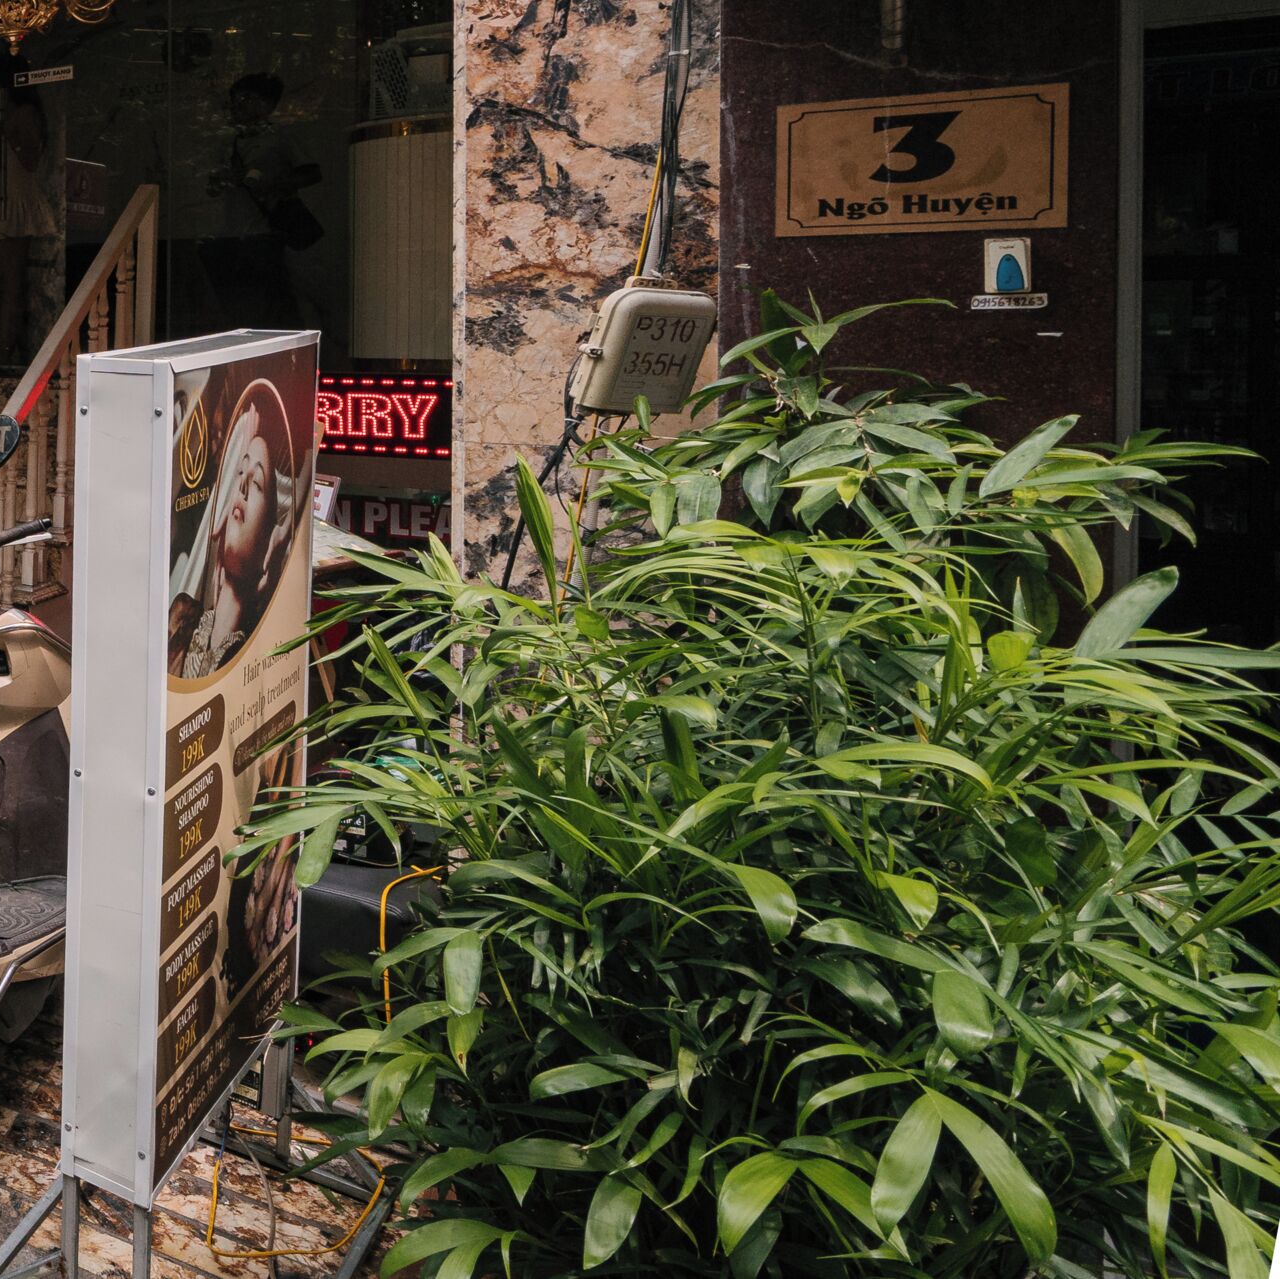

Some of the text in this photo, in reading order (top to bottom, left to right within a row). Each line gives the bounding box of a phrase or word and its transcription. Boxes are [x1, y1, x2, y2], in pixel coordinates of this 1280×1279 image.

[869, 110, 964, 183] 3
[817, 192, 1018, 220] Ngõ Huyện
[175, 491, 199, 512] CHERRY
[243, 656, 261, 687] Hair
[228, 665, 301, 736] and scalp treatment
[178, 706, 212, 744] SHAMPOO
[181, 733, 205, 774] 199K
[174, 769, 214, 815] NOURISHING
[178, 793, 209, 830] SHAMPOO
[178, 818, 203, 860] 199K
[167, 852, 216, 912] FOOT MASSAGE
[178, 886, 202, 929] 149K
[165, 919, 214, 983] BODY MASSAGE
[176, 951, 200, 998] 199K
[176, 997, 199, 1035] FACIAL
[175, 1019, 197, 1066] 199K
